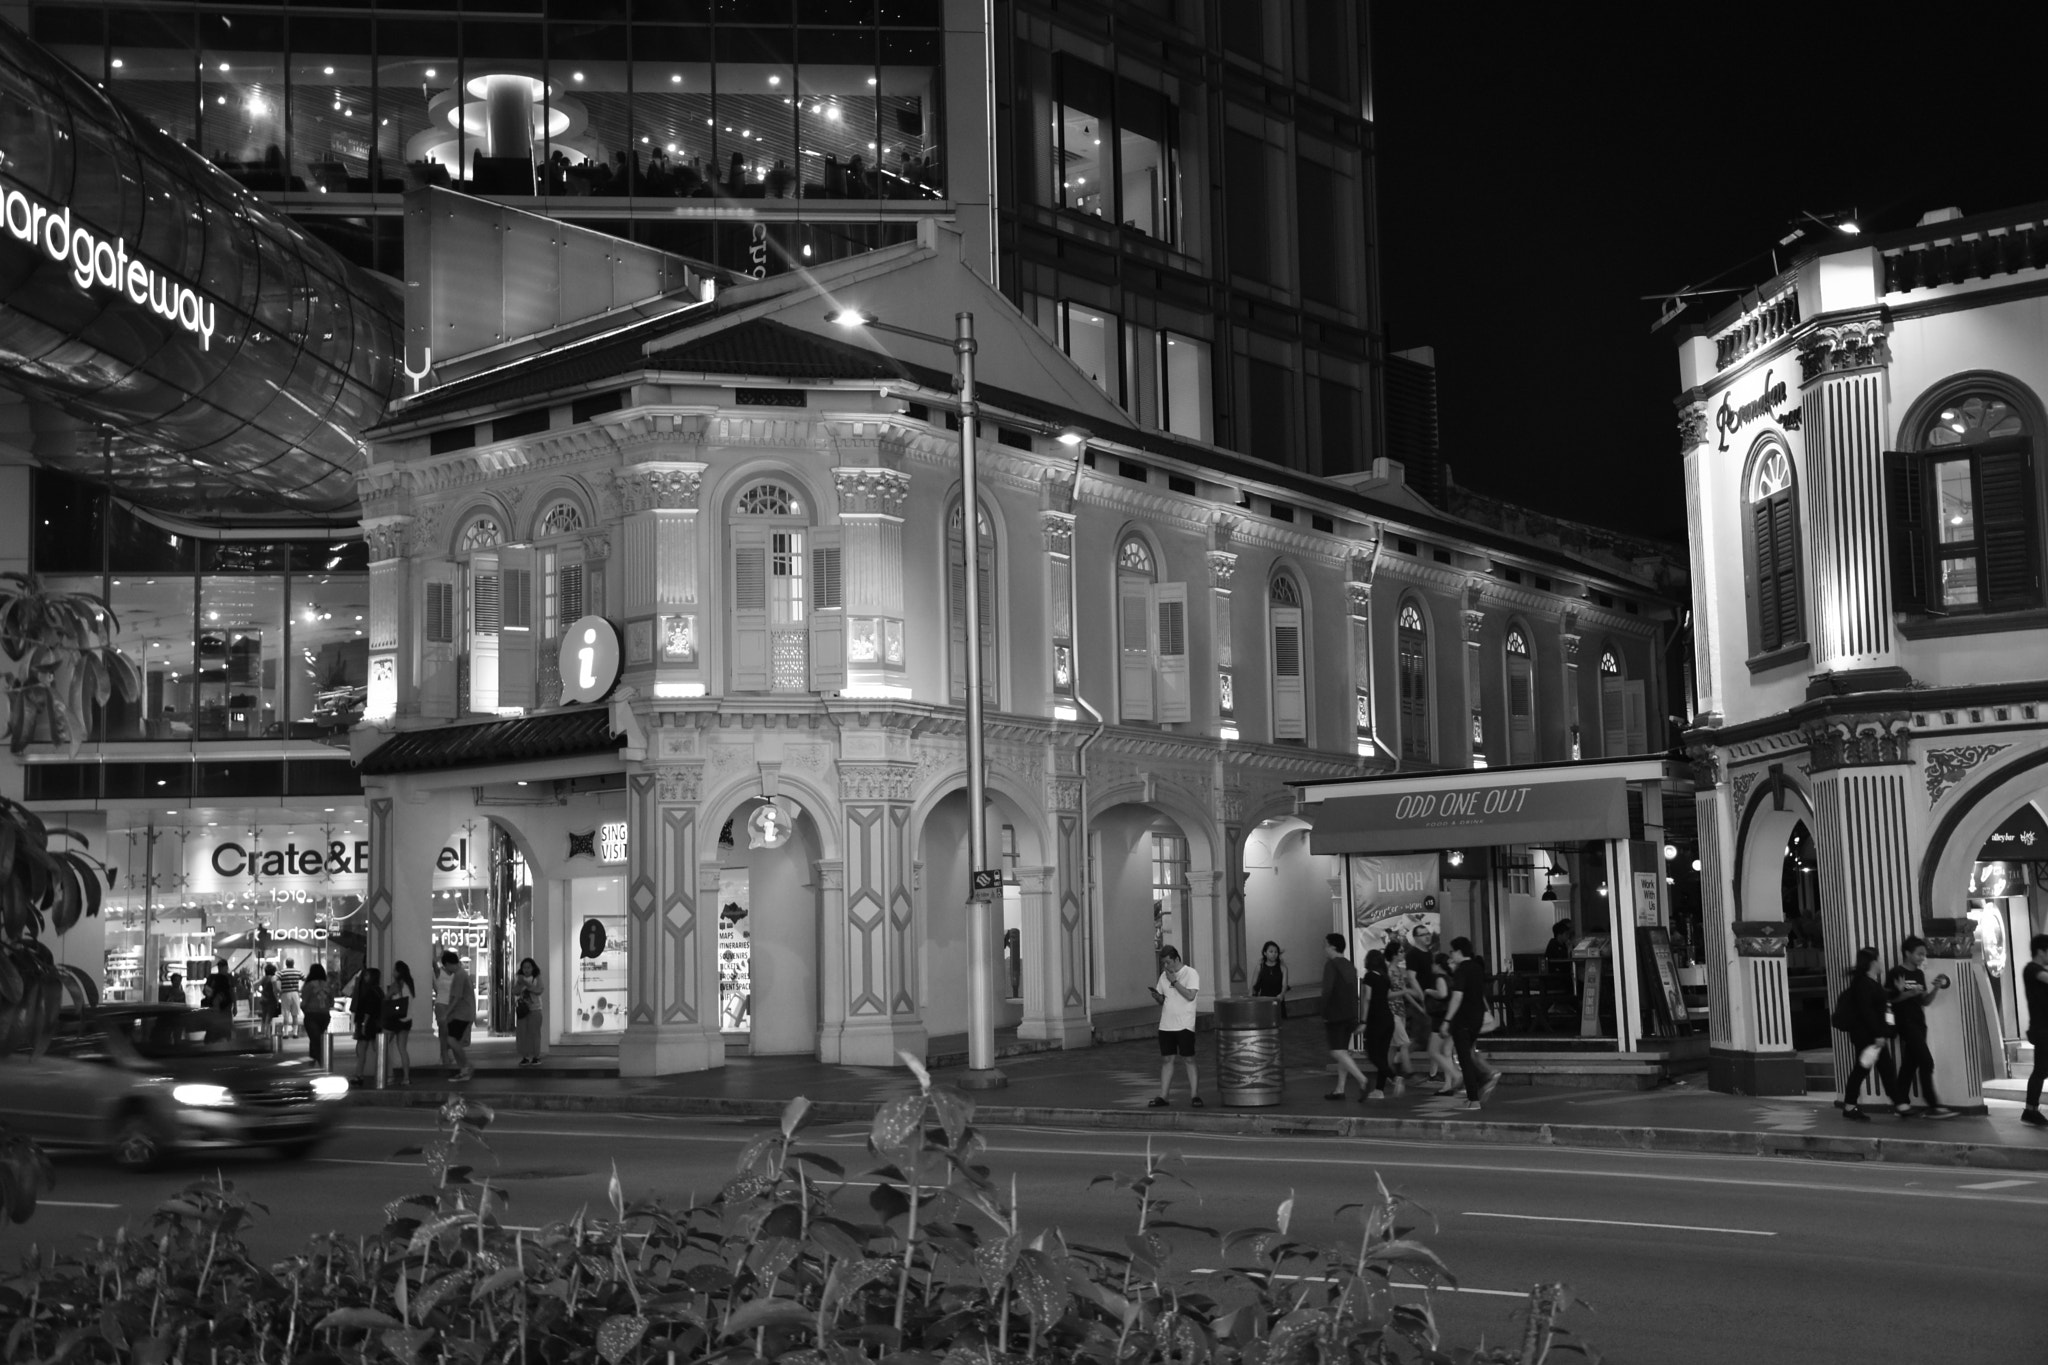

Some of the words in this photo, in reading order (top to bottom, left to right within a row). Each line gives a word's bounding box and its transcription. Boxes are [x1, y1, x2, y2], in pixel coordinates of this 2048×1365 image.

[0, 184, 215, 351] ardgateway
[1395, 794, 1436, 820] ODD
[1439, 791, 1481, 817] ONE
[1483, 787, 1532, 814] OUT
[1459, 818, 1485, 826] DRINK
[1377, 871, 1424, 893] LUNCH
[1641, 879, 1655, 889] Work
[1643, 889, 1656, 900] With
[1648, 900, 1656, 911] Us
[719, 932, 734, 940] MAPS
[719, 941, 750, 949] ITINERARIES
